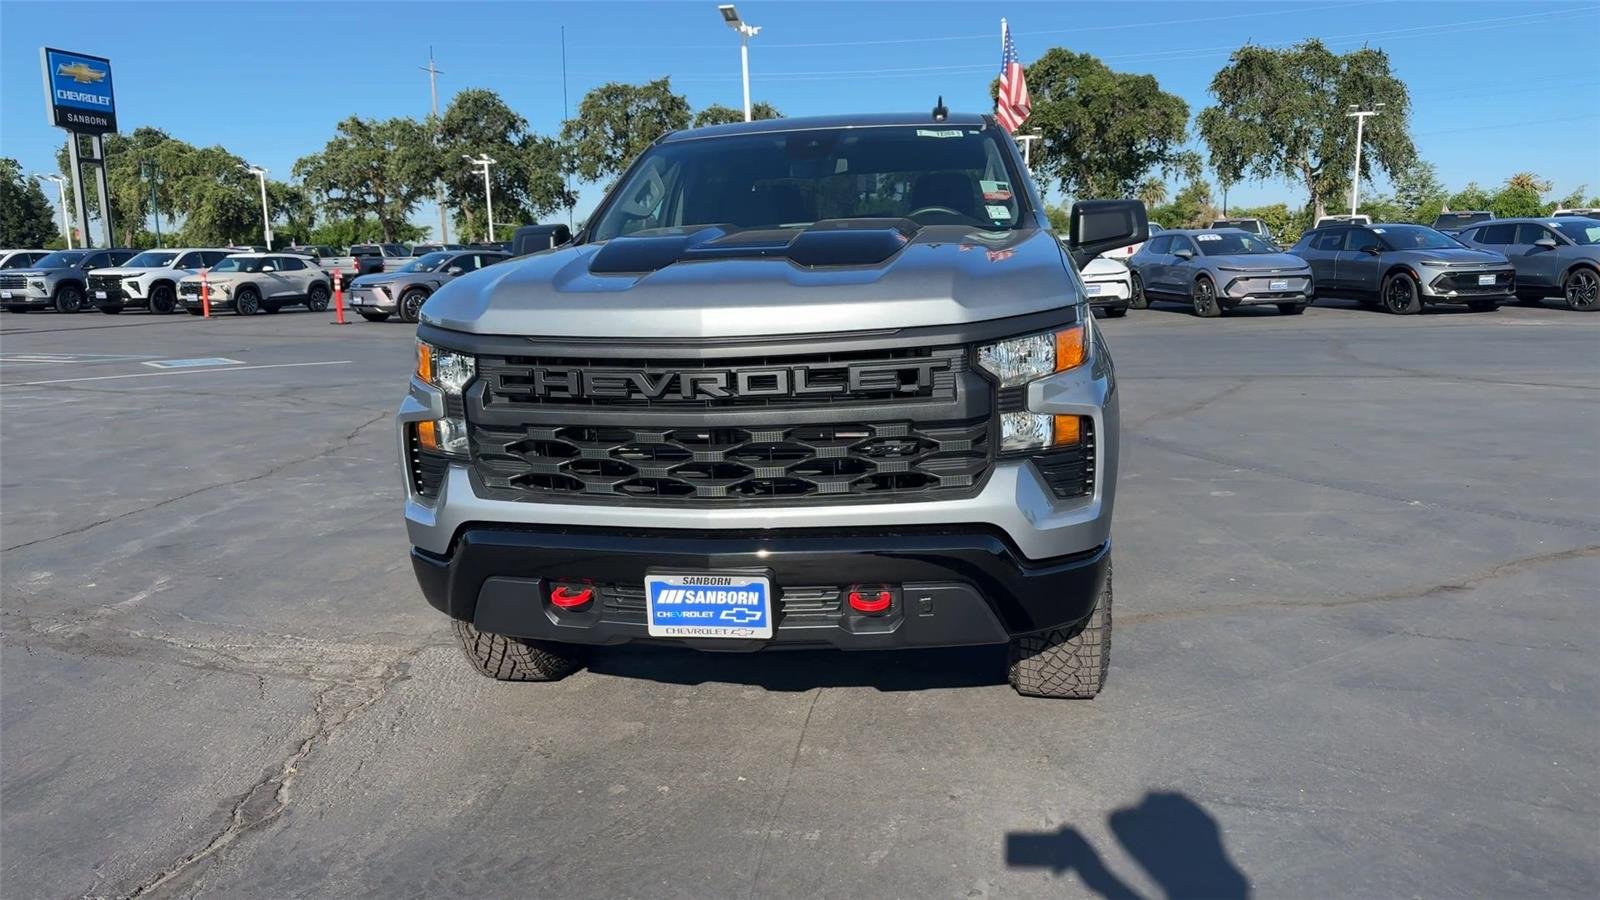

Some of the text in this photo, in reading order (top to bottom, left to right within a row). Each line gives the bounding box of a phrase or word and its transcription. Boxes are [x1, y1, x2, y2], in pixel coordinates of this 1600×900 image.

[57, 89, 110, 106] CHEVROLET
[67, 113, 108, 126] SANBORN
[492, 357, 951, 400] CHEVROLET
[682, 576, 732, 586] SANBORN
[684, 590, 759, 605] SANBORN
[665, 627, 728, 635] CHEVROLET
